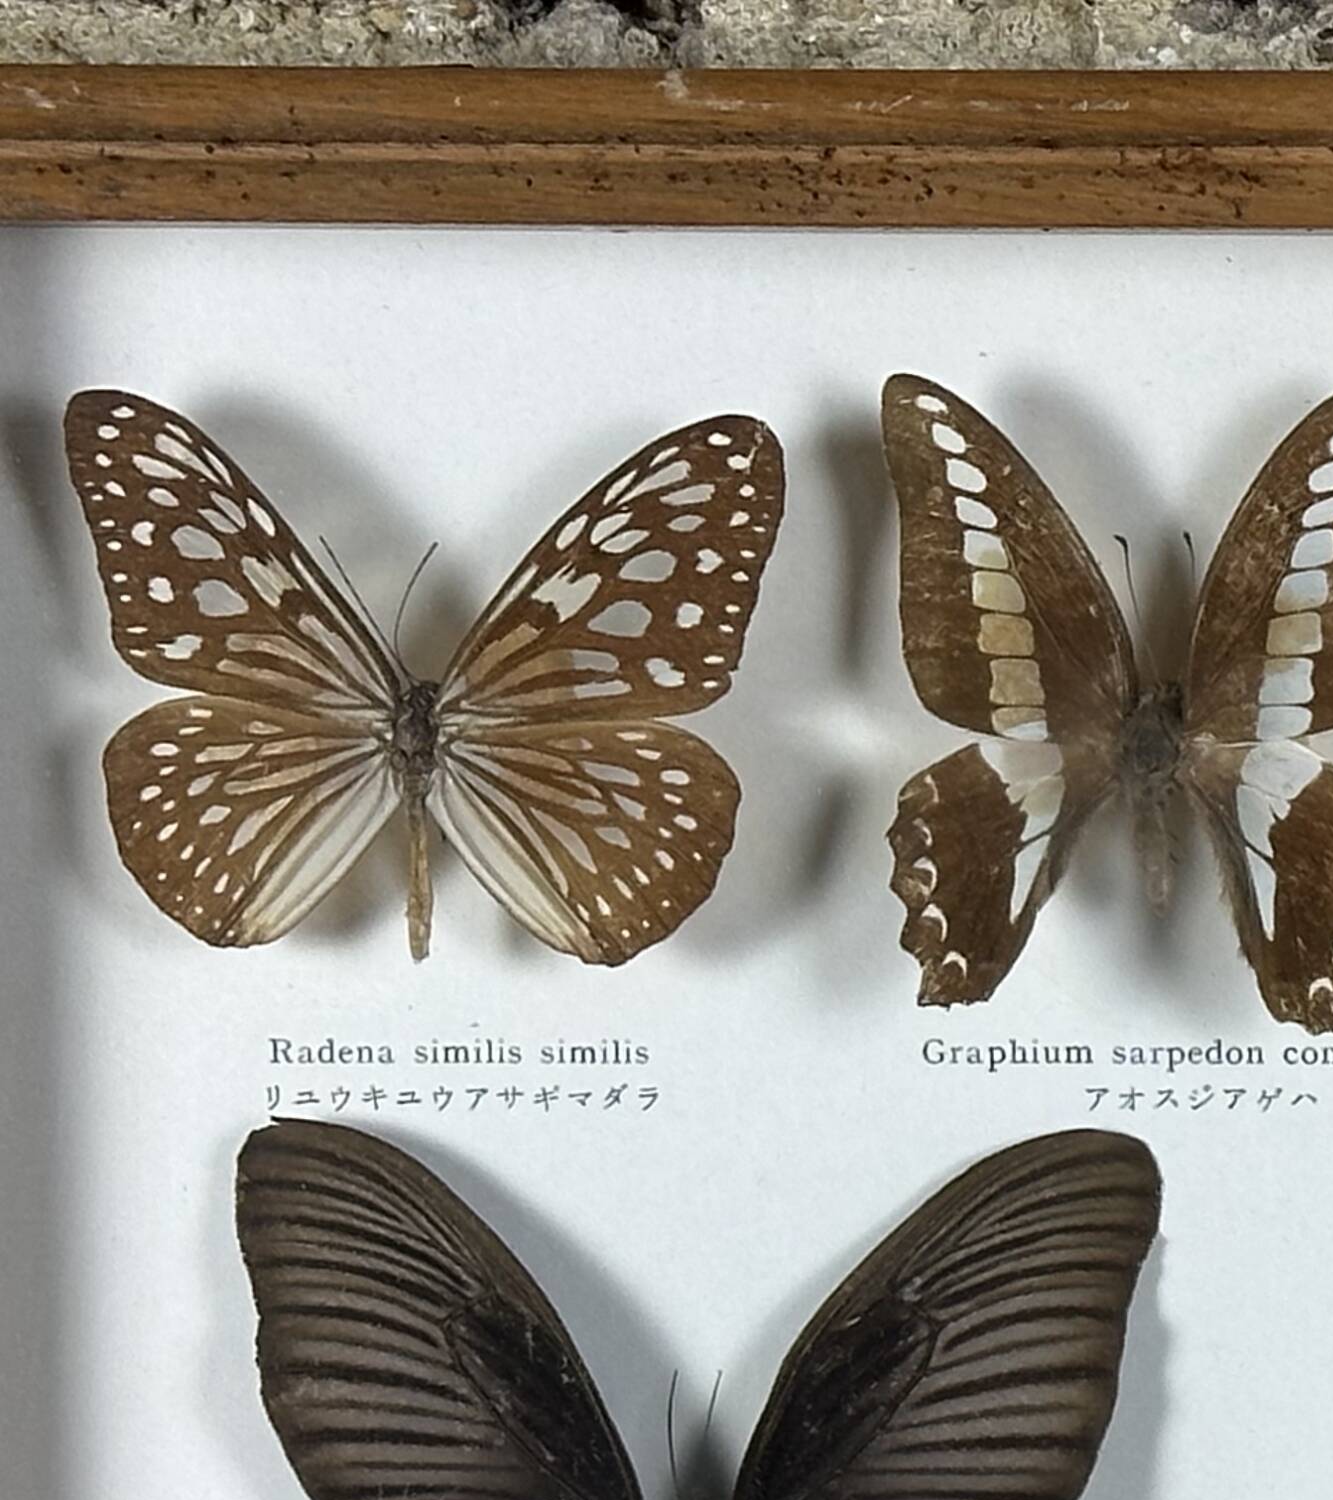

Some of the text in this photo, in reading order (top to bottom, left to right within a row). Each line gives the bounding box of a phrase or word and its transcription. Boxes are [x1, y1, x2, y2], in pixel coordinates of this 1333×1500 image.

[267, 1037, 650, 1066] Radena similis similis
[921, 1037, 1095, 1074] Graphium
[1111, 1038, 1265, 1074] sarpedon
[1084, 1083, 1319, 1113] アオスジアゲハ
